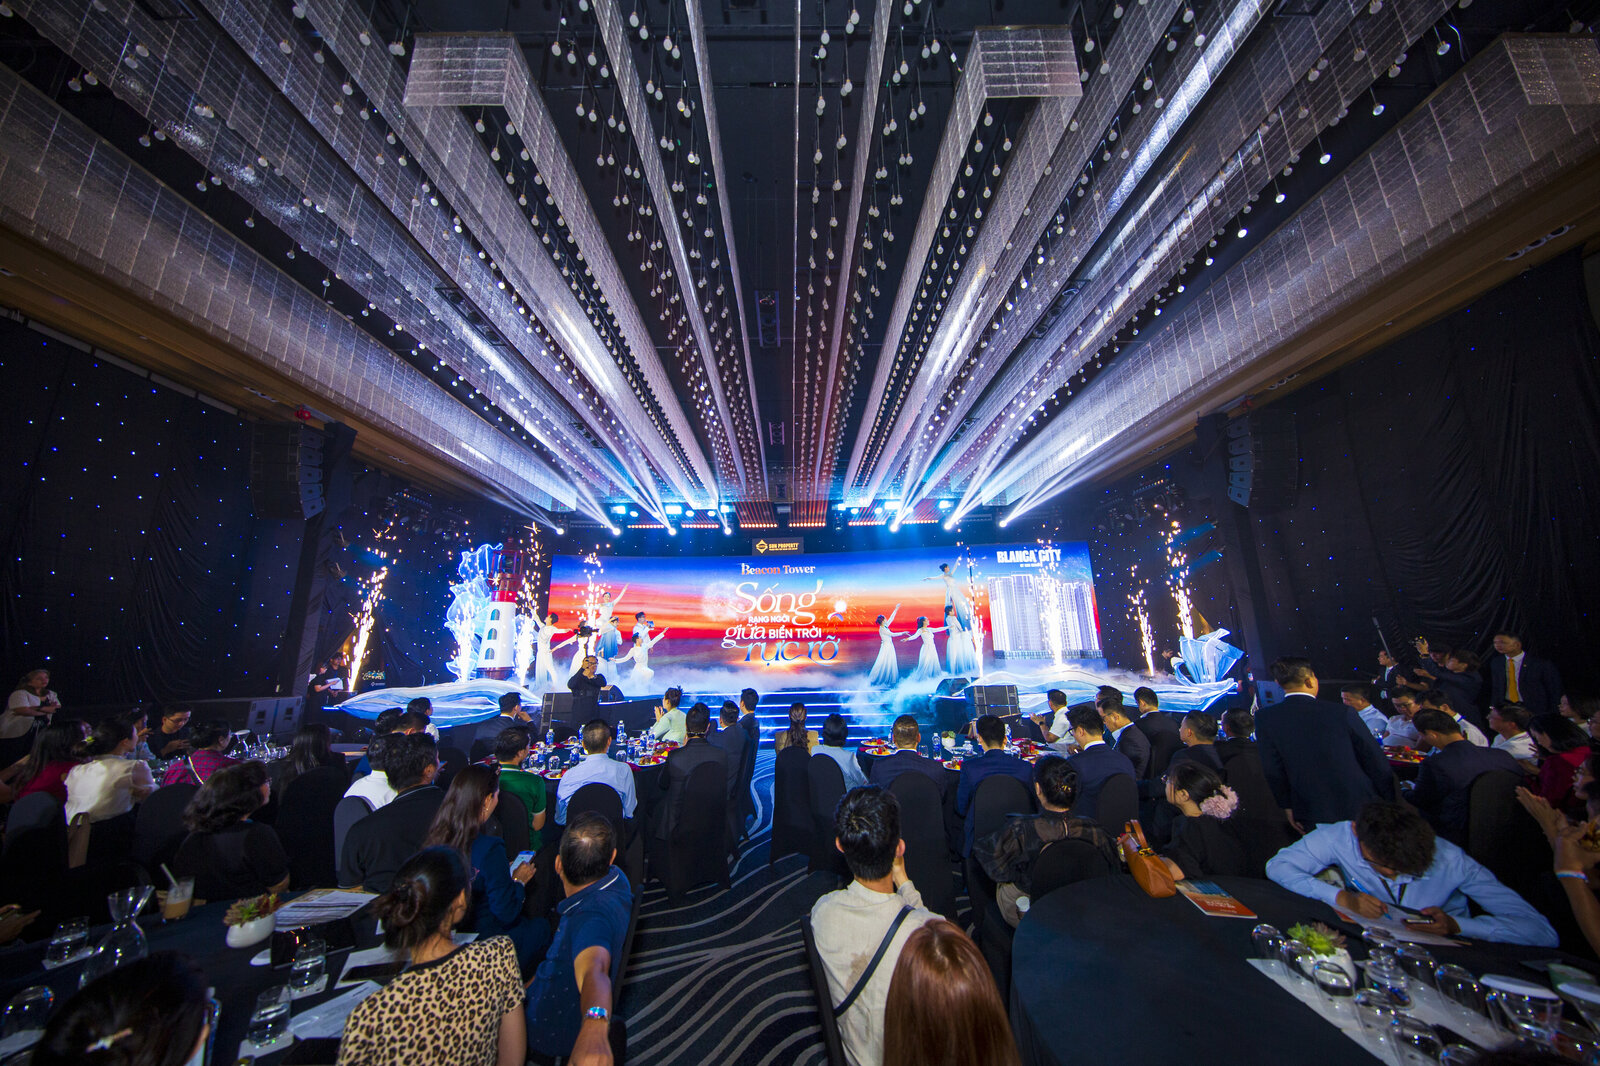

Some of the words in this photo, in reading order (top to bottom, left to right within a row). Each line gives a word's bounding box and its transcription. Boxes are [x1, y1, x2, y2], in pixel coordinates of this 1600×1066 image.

[741, 563, 781, 575] Beacon
[782, 565, 816, 574] Tower
[728, 579, 824, 626] Sống
[721, 624, 767, 649] giữa
[768, 625, 793, 639] BIỂN
[795, 625, 822, 638] TRỜI
[744, 639, 800, 666] rực
[807, 635, 841, 667] rỡ
